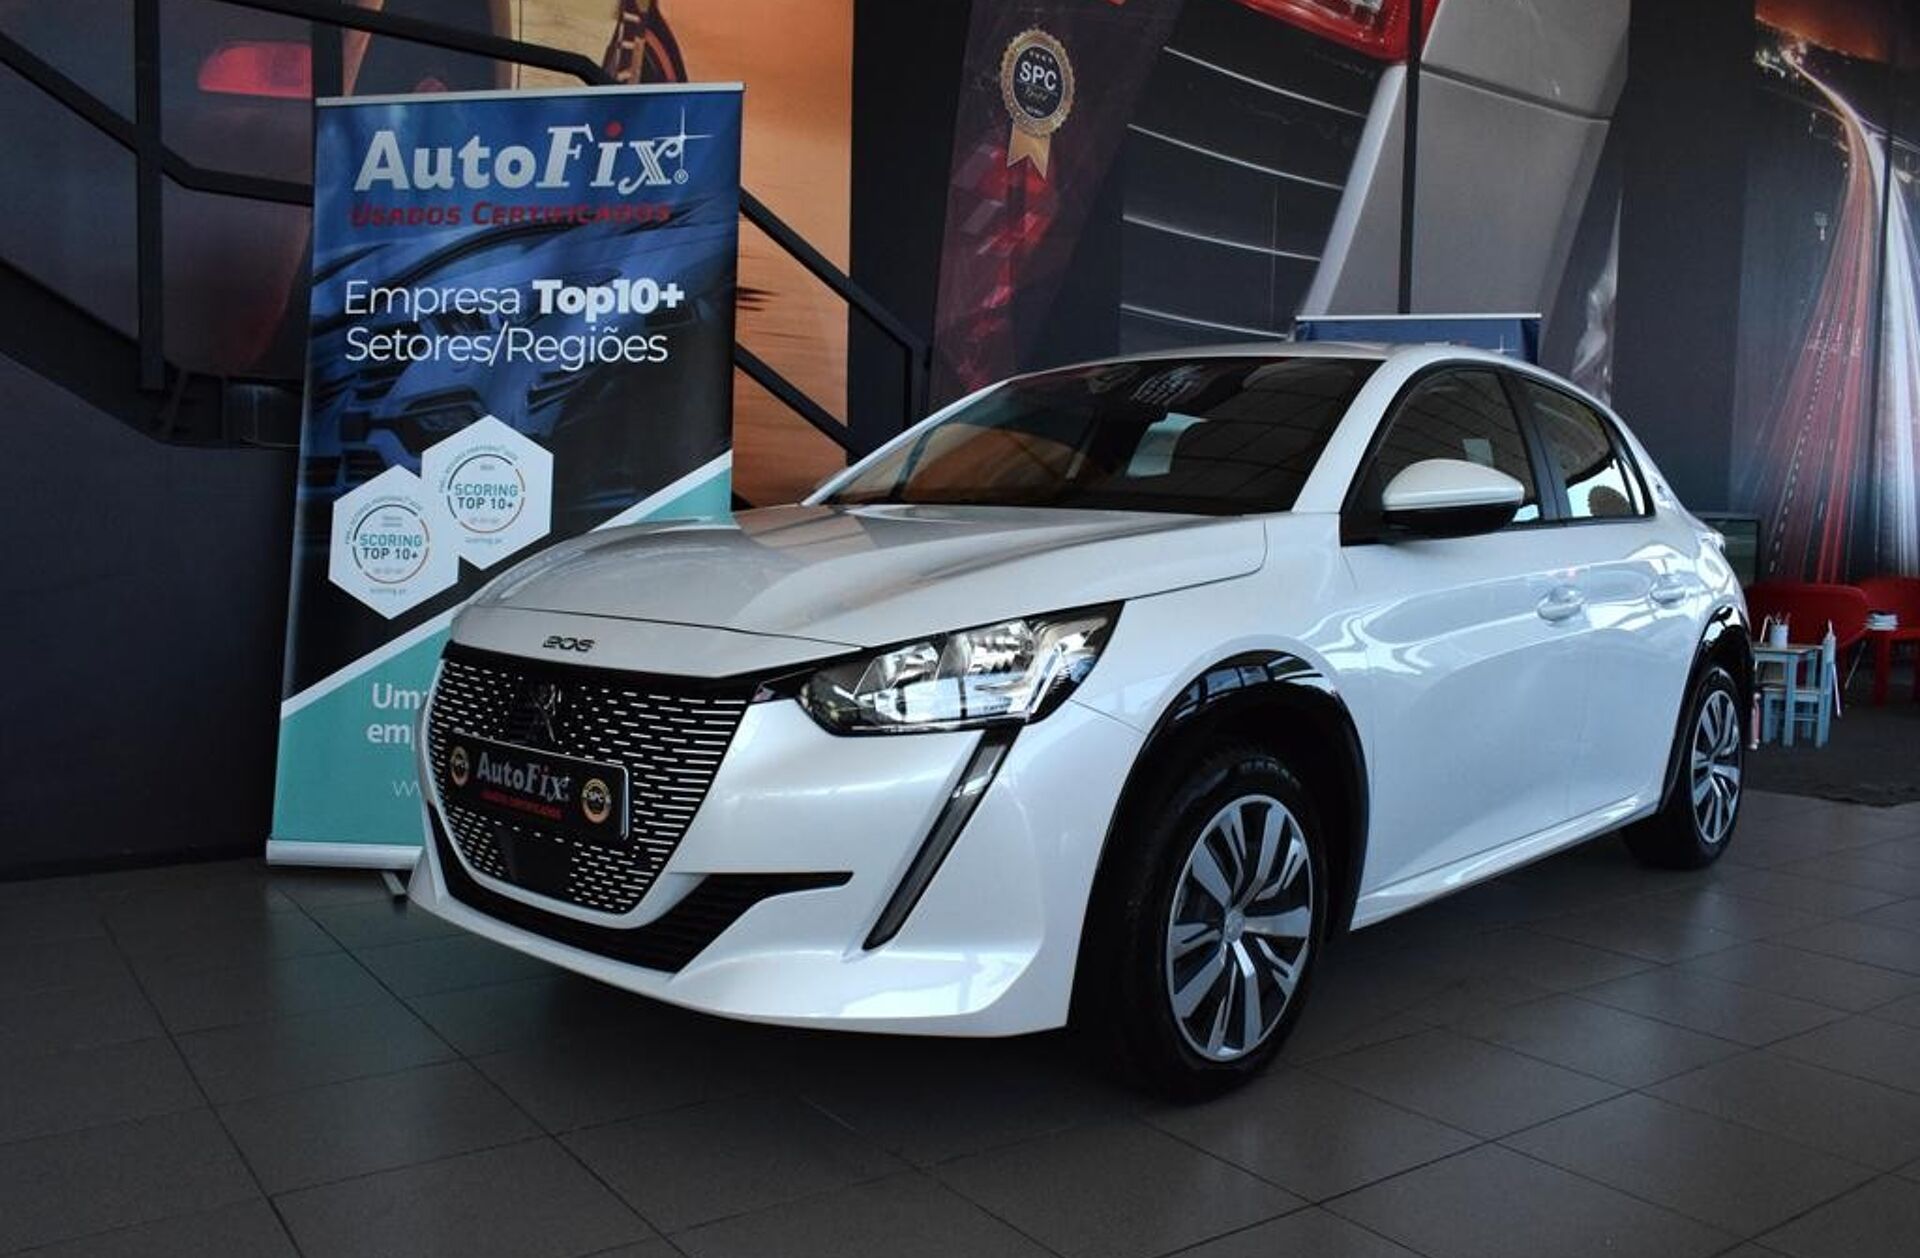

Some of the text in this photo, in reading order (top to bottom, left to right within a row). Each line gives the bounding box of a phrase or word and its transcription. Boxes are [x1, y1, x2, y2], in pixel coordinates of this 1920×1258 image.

[1019, 61, 1057, 90] SPC
[344, 278, 685, 323] Empresa Top10+
[344, 321, 669, 371] Setores/Regiões
[454, 483, 519, 498] SCORING
[457, 497, 514, 510] TOP 10+
[359, 533, 423, 548] SCORING
[362, 547, 418, 561] TOP 10+
[372, 683, 428, 710] Um
